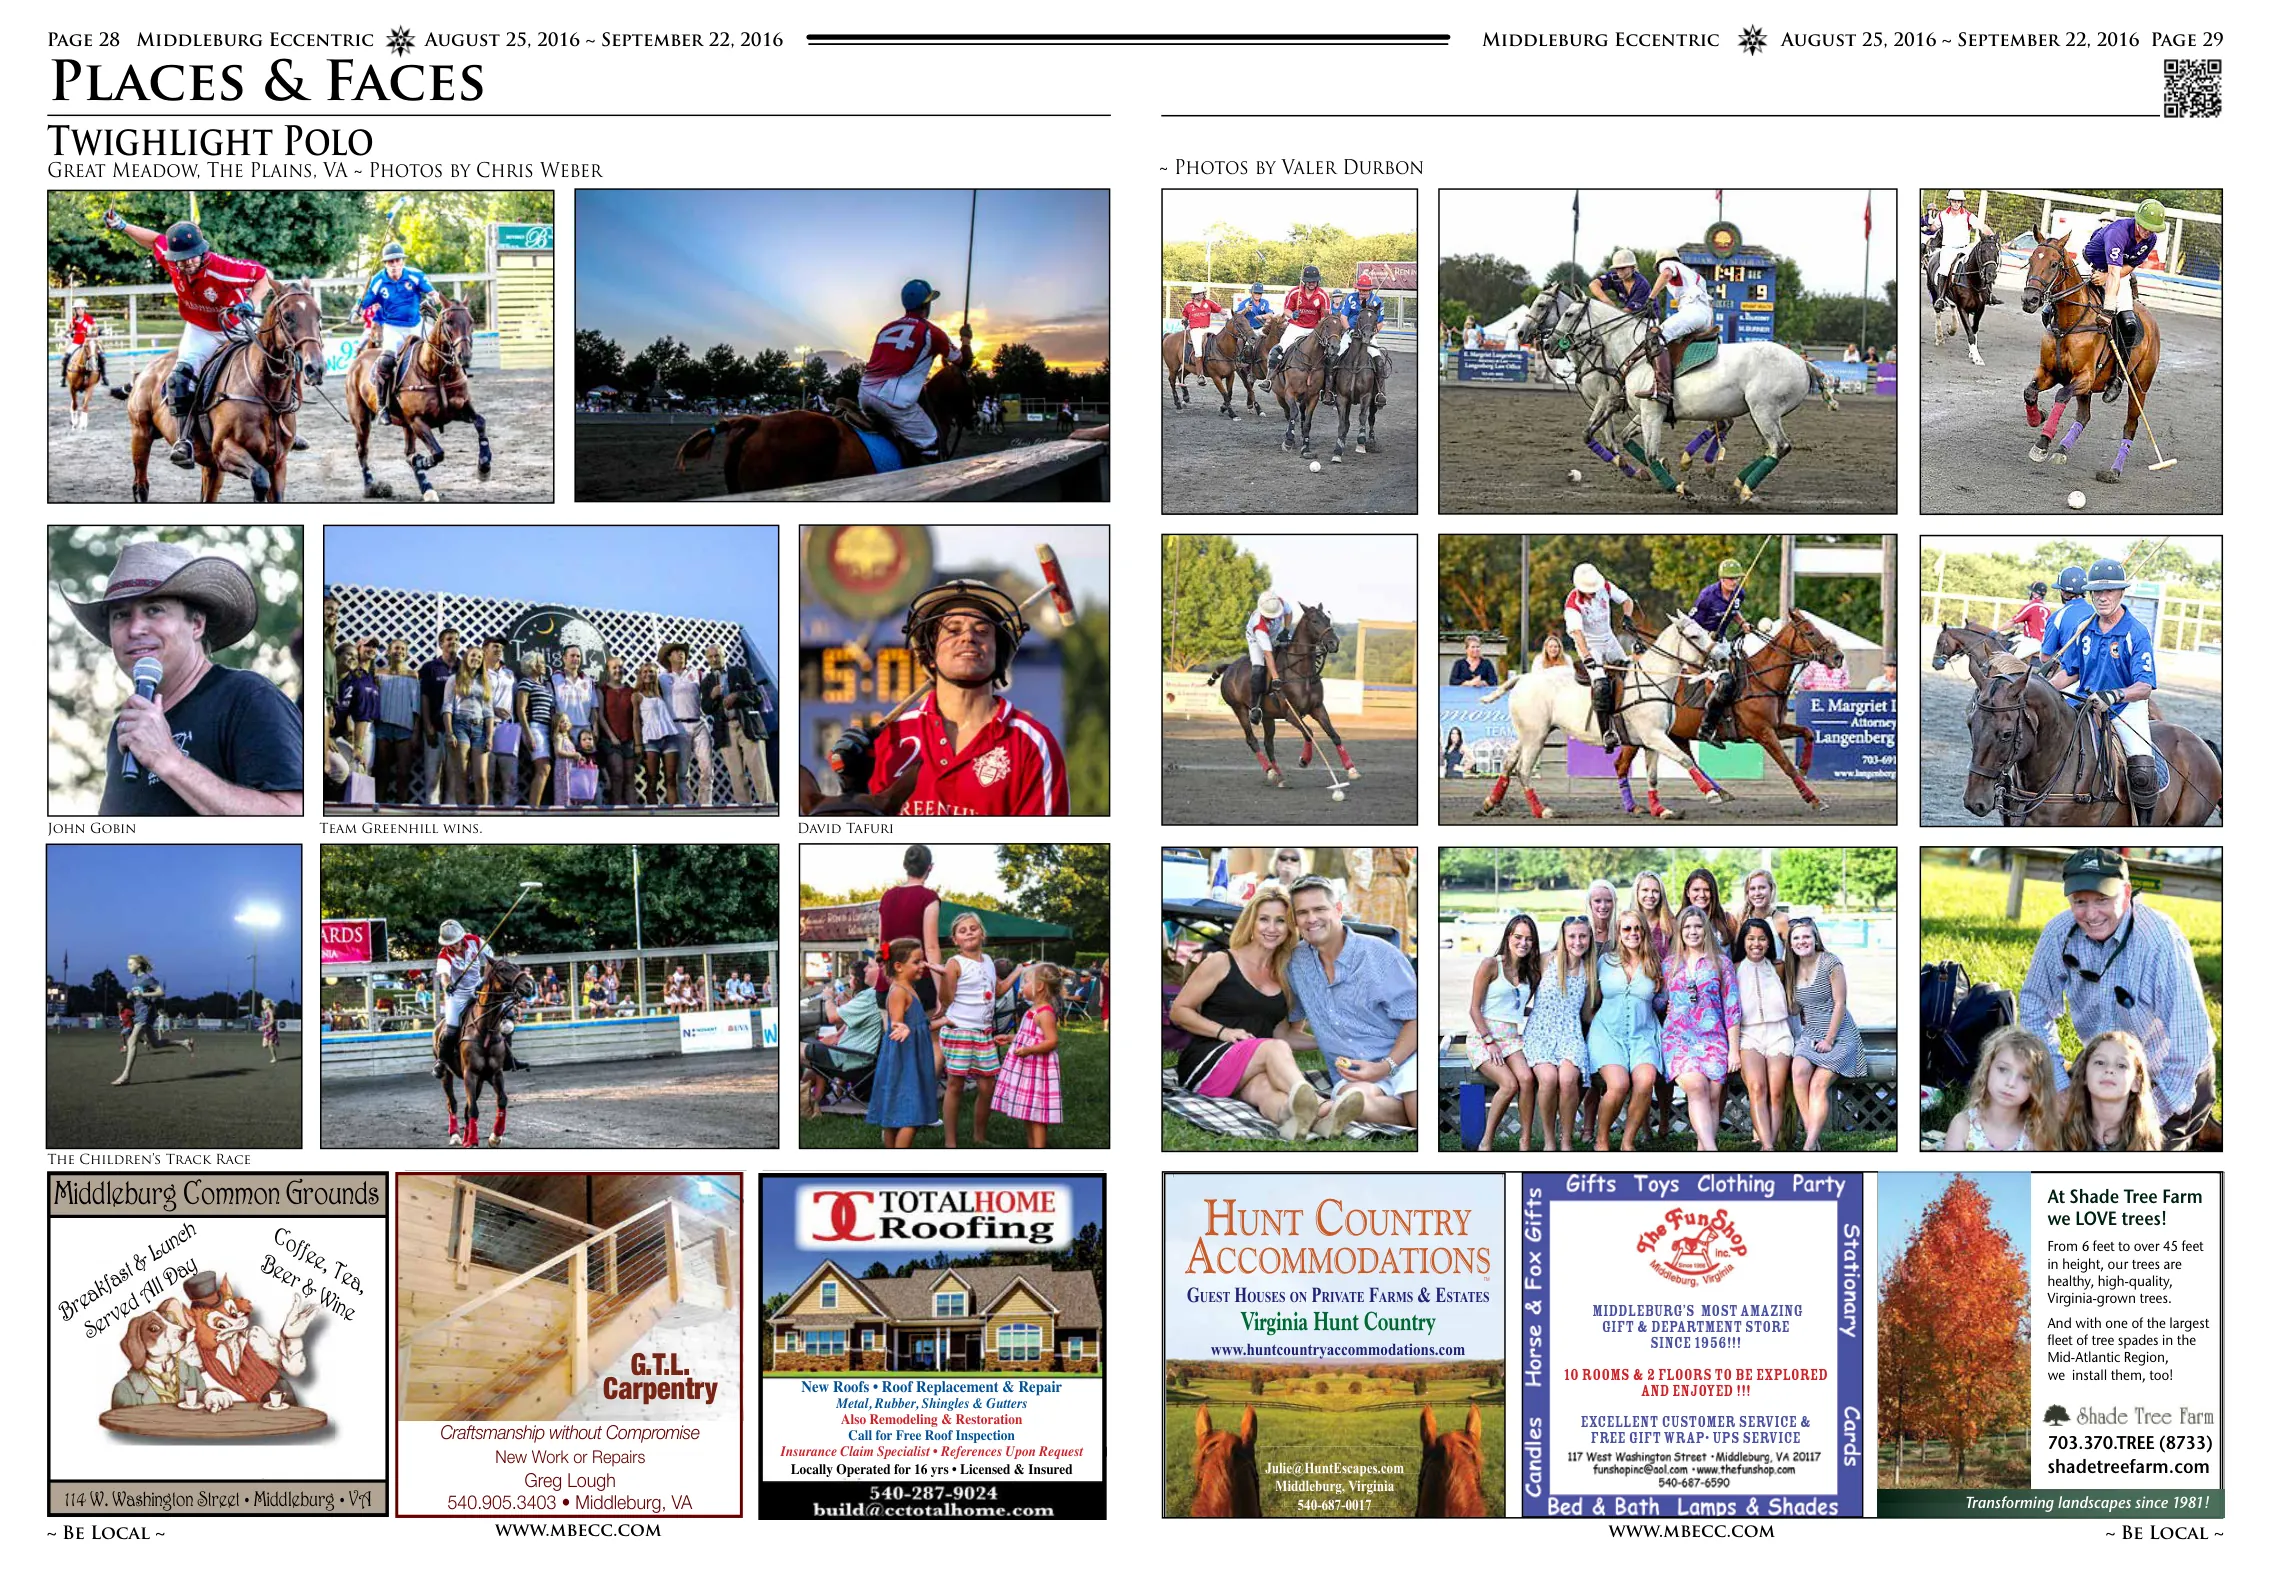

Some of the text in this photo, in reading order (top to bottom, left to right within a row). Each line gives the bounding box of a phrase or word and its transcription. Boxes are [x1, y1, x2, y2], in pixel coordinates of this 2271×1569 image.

[48, 32, 373, 47] PAGE 28 MIDDLEBURG ECCENTRIC
[424, 32, 500, 47] AUGUST
[506, 32, 531, 48] 25,
[538, 32, 580, 47] 2016
[602, 32, 704, 47] SEPTEMBER
[709, 32, 734, 48] 22,
[741, 32, 783, 47] 2016
[2152, 32, 2223, 47] PAGE 29
[51, 56, 483, 101] PLACES & FACES
[47, 124, 373, 156] TWIGHLIGHT POLO
[48, 161, 106, 178] GREAT
[113, 162, 200, 179] MEADOW,
[207, 162, 243, 177] THE
[251, 162, 316, 179] PLAINS,
[323, 162, 348, 177] VA
[370, 162, 442, 178] PHOTOS
[451, 164, 471, 177] BY
[477, 161, 533, 178] CHRIS
[540, 162, 603, 178] WEBER
[1176, 159, 1248, 175] PHOTOS
[1256, 161, 1276, 174] BY
[1281, 159, 1338, 174] VALER
[1344, 159, 1423, 175] DURBON
[1756, 284, 1768, 301] 9
[877, 324, 915, 351] 4
[2081, 635, 2092, 656] 3
[2141, 652, 2154, 673] 3
[1811, 699, 1888, 716] E. Margriet
[1815, 730, 1895, 748] Langenberg
[893, 736, 921, 778] 2
[48, 822, 135, 836] JOHN GOBIN
[319, 822, 482, 834] TEAM GREENHILL WINS.
[799, 822, 893, 834] DAVID TAFURI
[47, 1153, 74, 1164] THE
[166, 1153, 212, 1165] TRACK
[217, 1153, 250, 1165] RACE
[54, 1179, 379, 1212] Middleburg Common Grounds
[1567, 1175, 1845, 1198] Gifts Toys Clothing Party
[879, 1191, 1055, 1213] TOTALHOME
[1204, 1199, 1472, 1236] HUNT COUNTRY
[2048, 1211, 2166, 1226] we LOVE trees!
[879, 1216, 1054, 1245] Roofing
[274, 1227, 364, 1296] Coffee, Tea,
[1185, 1237, 1490, 1274] ACCOMMODATIONS
[58, 1222, 198, 1321] Breakfast & Lunch
[1839, 1223, 1860, 1337] Stationary
[1701, 1305, 1737, 1316] MOST
[1740, 1305, 1802, 1316] AMAZING
[1211, 1344, 1465, 1359] www.huntcountryaccommodations.com
[632, 1353, 689, 1375] G.T.L.
[604, 1374, 717, 1404] Carpentry
[441, 1425, 700, 1443] Craftsmanship without Compromise
[1844, 1406, 1861, 1467] Cards
[780, 1446, 1083, 1459] Insurance Claim Specialist References Upon Request
[2049, 1435, 2212, 1453] 703.370.TREE (8733)
[1524, 1417, 1542, 1498] Candles
[2048, 1459, 2209, 1474] shadetreefarm.com
[1276, 1481, 1393, 1494] Middleburg, Virginia
[1659, 1478, 1730, 1488] 540-687-6590
[65, 1490, 371, 1511] 114 W. Washington Street Middleburg VA
[870, 1486, 998, 1500] 540-287-9024
[448, 1495, 692, 1513] 540.905.3403 Middleburg, VA
[1298, 1500, 1371, 1510] 540-687-0017
[1967, 1496, 2209, 1512] Transforming landscapes since 1981!
